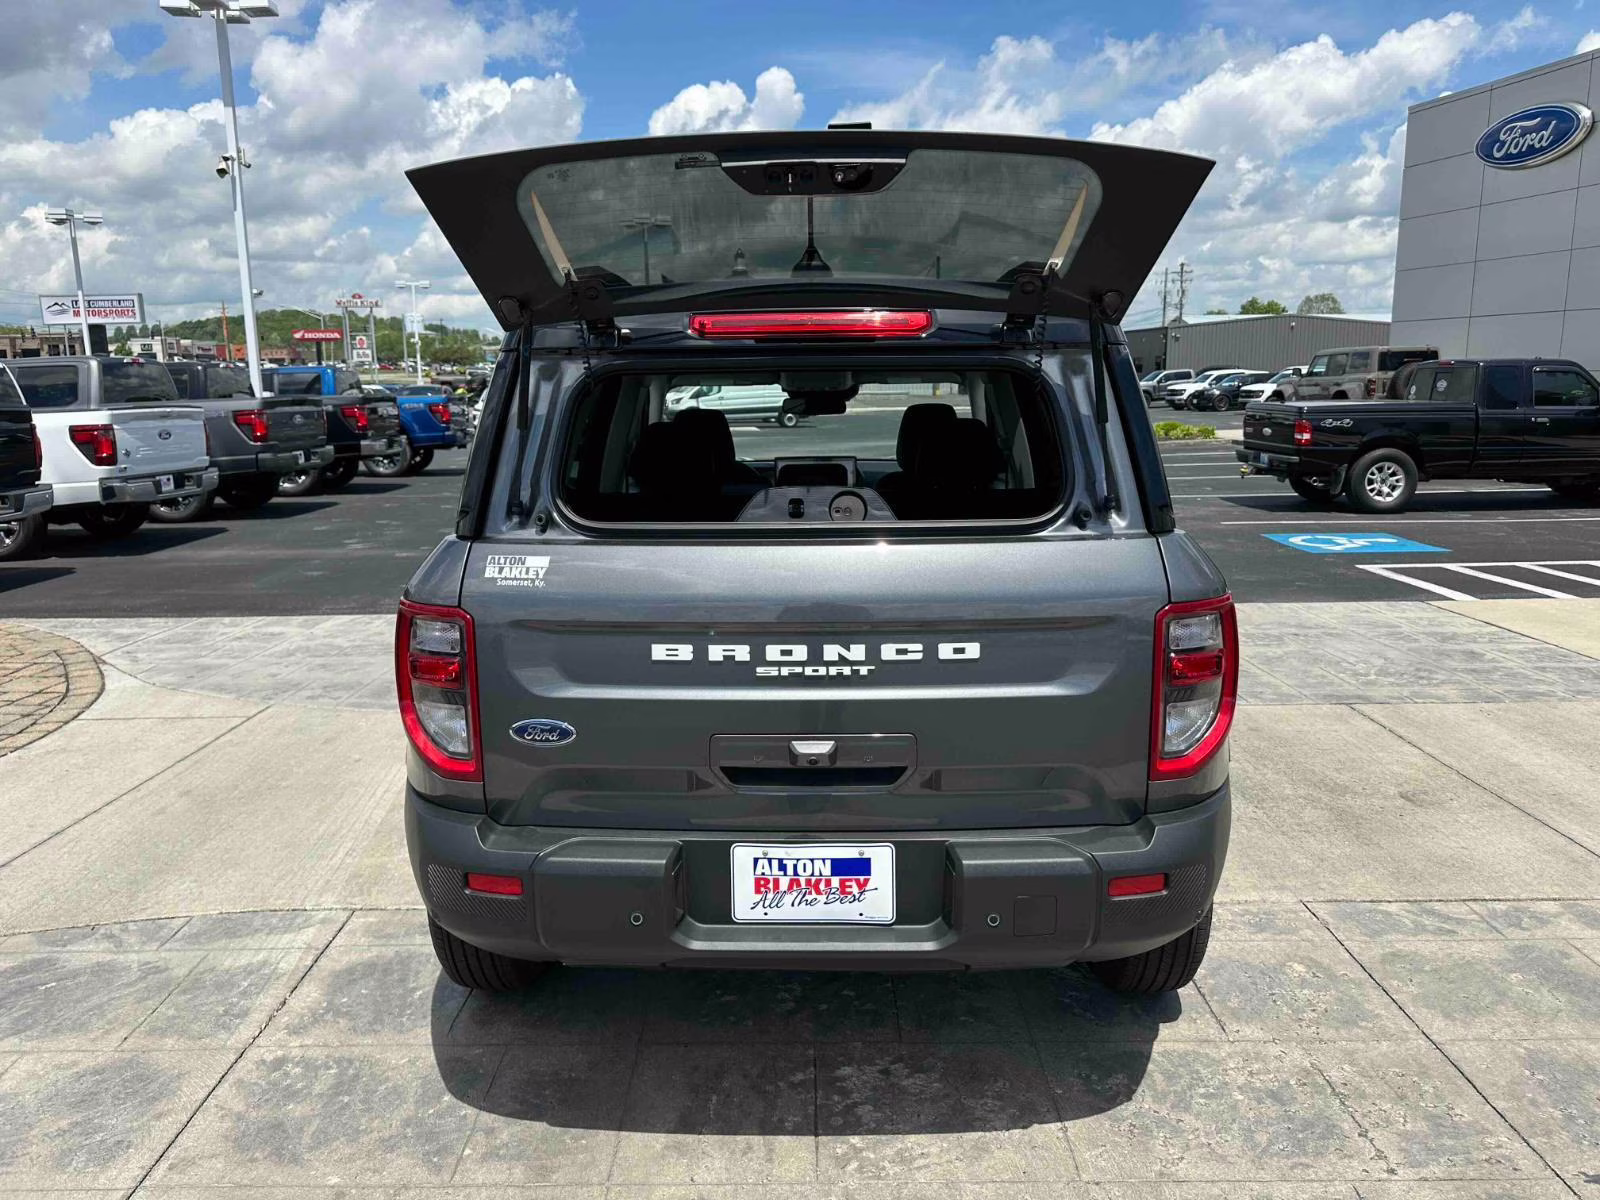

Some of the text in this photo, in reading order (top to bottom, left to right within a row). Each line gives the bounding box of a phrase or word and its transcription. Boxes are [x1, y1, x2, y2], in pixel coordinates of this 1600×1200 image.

[1493, 117, 1557, 158] Ford
[89, 300, 134, 308] CUMBERLAND
[73, 308, 136, 317] MTORSPORTS
[488, 556, 527, 566] ALTON
[484, 566, 548, 578] BLAKLEY
[496, 578, 546, 588] Somerset, Ky.
[651, 642, 981, 662] BRONCO
[755, 665, 876, 676] SPORT
[524, 724, 561, 740] Ford
[754, 858, 832, 876] ALTON
[754, 877, 871, 896] BLAKLEY
[750, 886, 878, 910] All The Best
